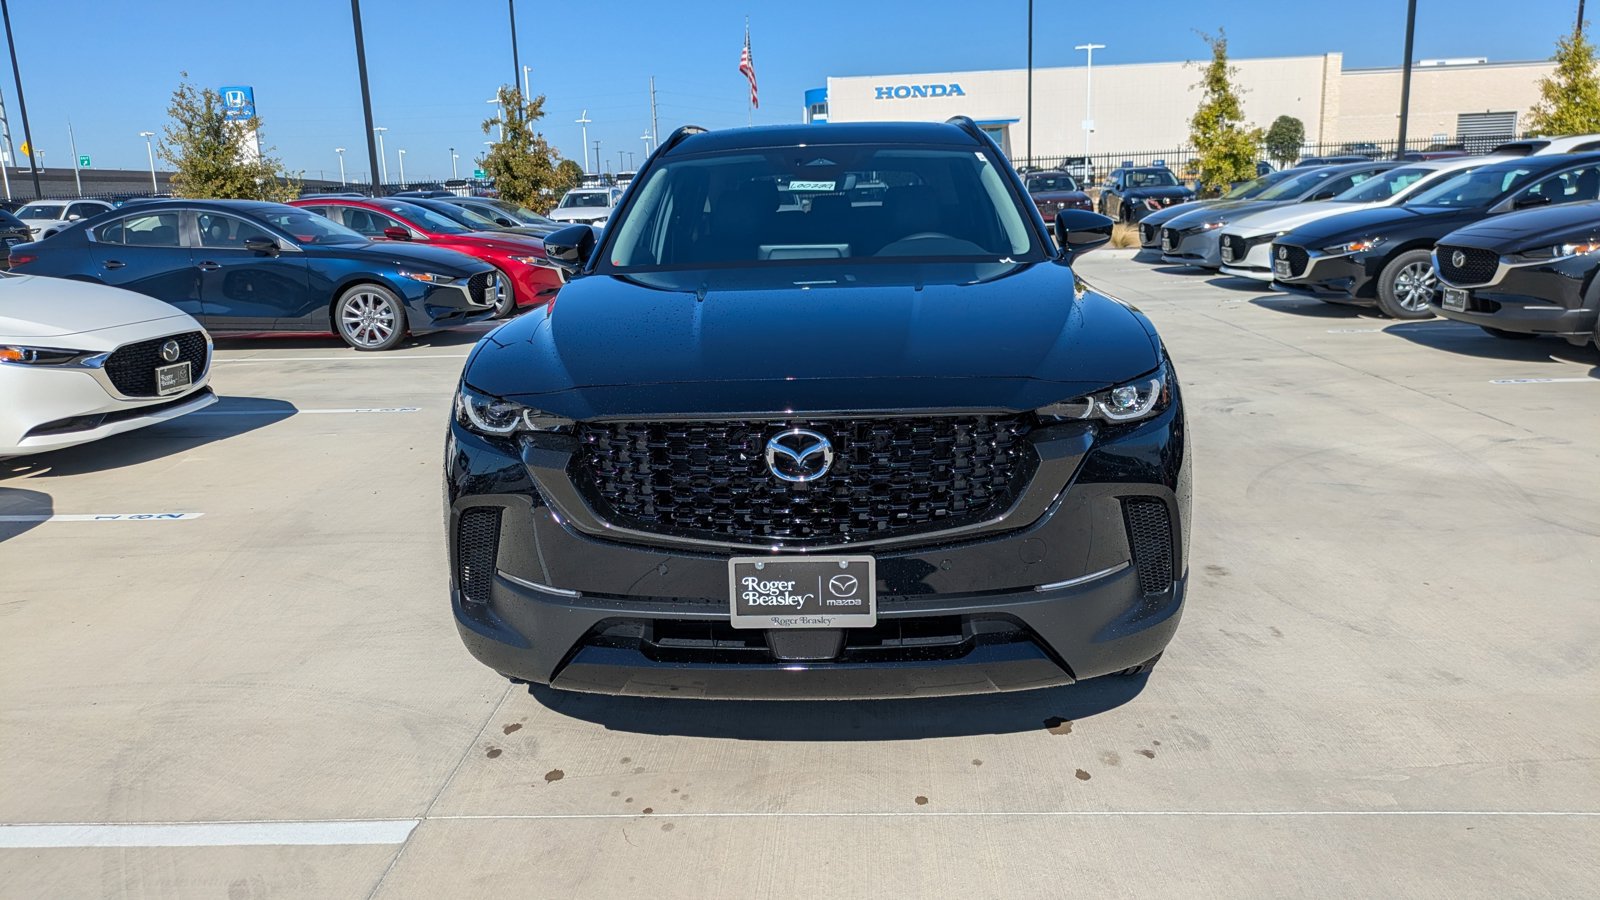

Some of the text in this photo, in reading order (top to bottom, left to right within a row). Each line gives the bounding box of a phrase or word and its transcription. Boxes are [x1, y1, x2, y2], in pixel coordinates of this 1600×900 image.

[874, 83, 966, 100] HONDA
[742, 577, 796, 595] Roger
[742, 592, 814, 609] Beasley
[770, 616, 836, 627] Roger Beasley
